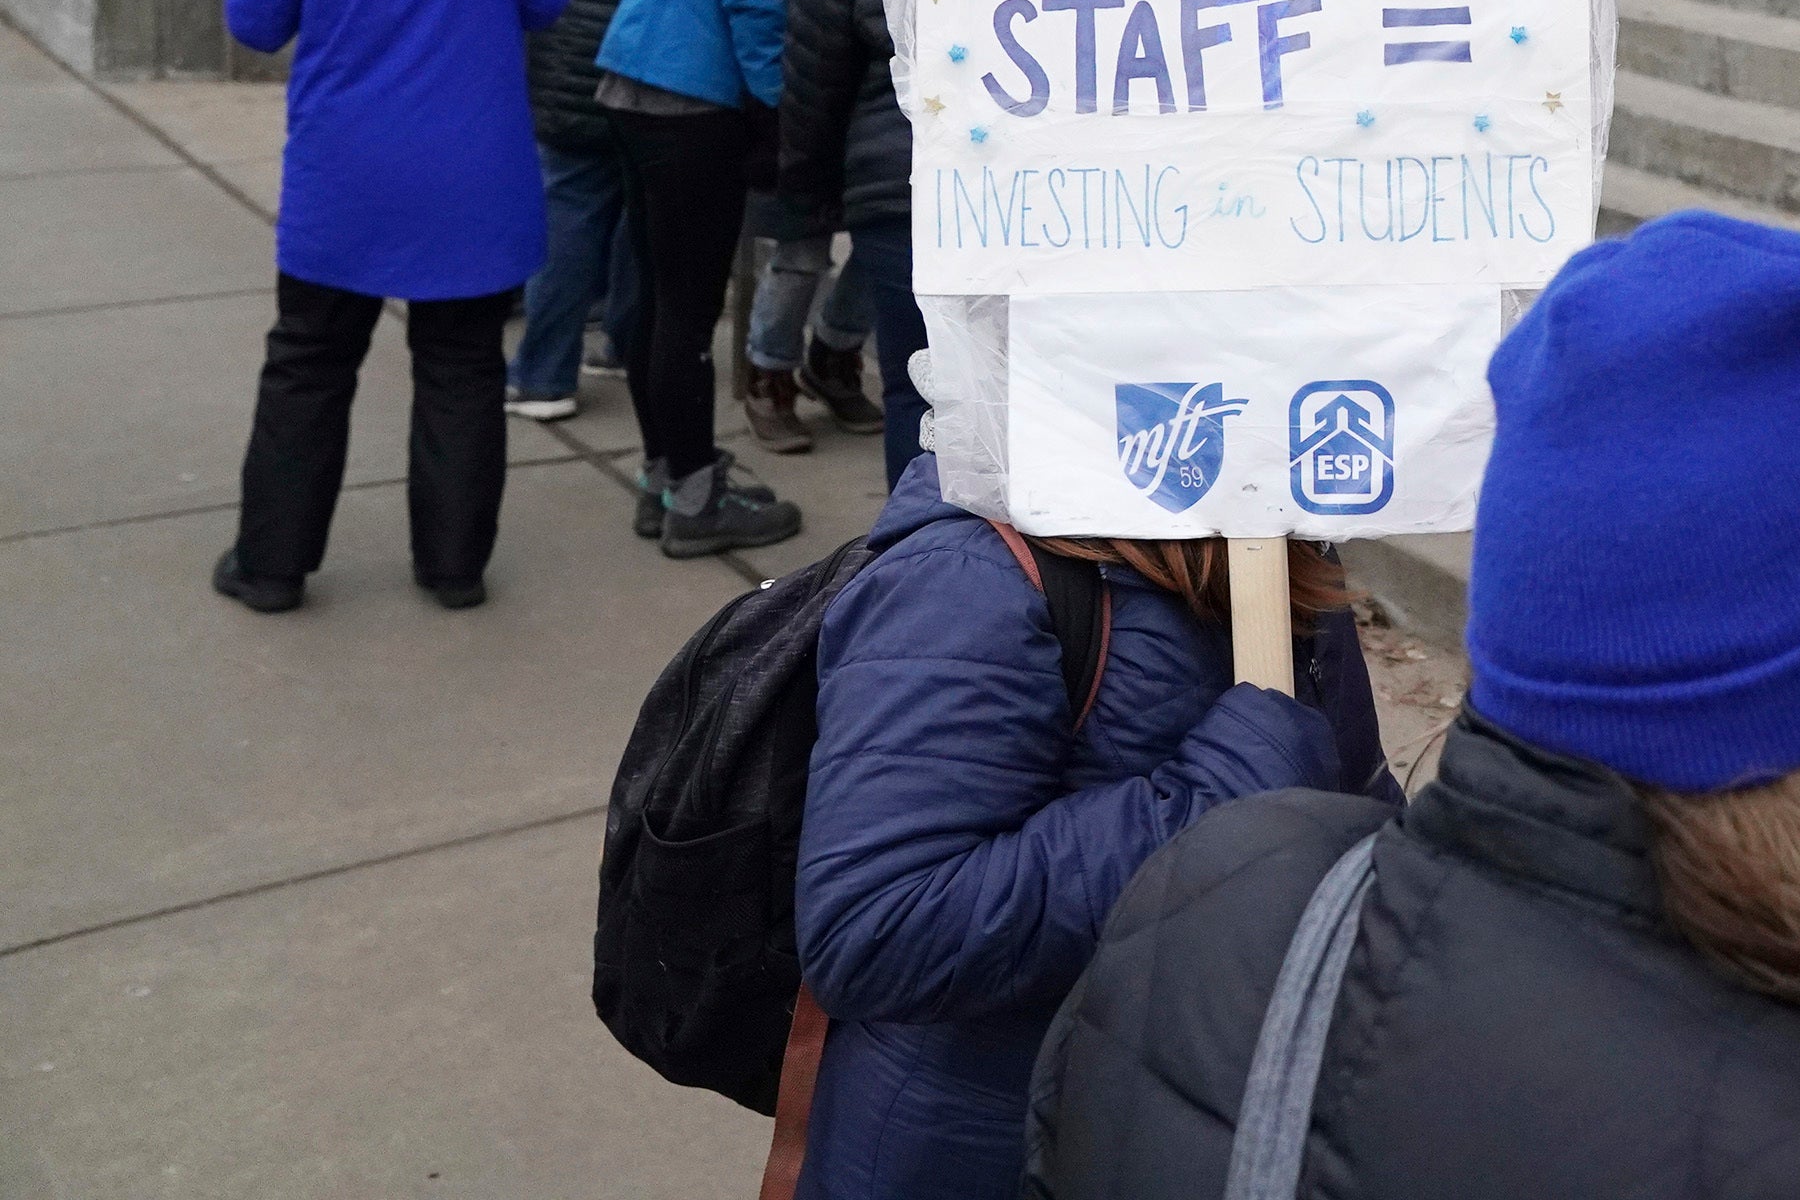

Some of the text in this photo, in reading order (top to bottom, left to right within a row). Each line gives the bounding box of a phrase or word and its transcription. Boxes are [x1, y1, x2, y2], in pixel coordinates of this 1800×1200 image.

[936, 155, 1556, 250] INVESTING in STUDENTS
[1180, 465, 1204, 488] 59
[1317, 454, 1369, 483] ESP
